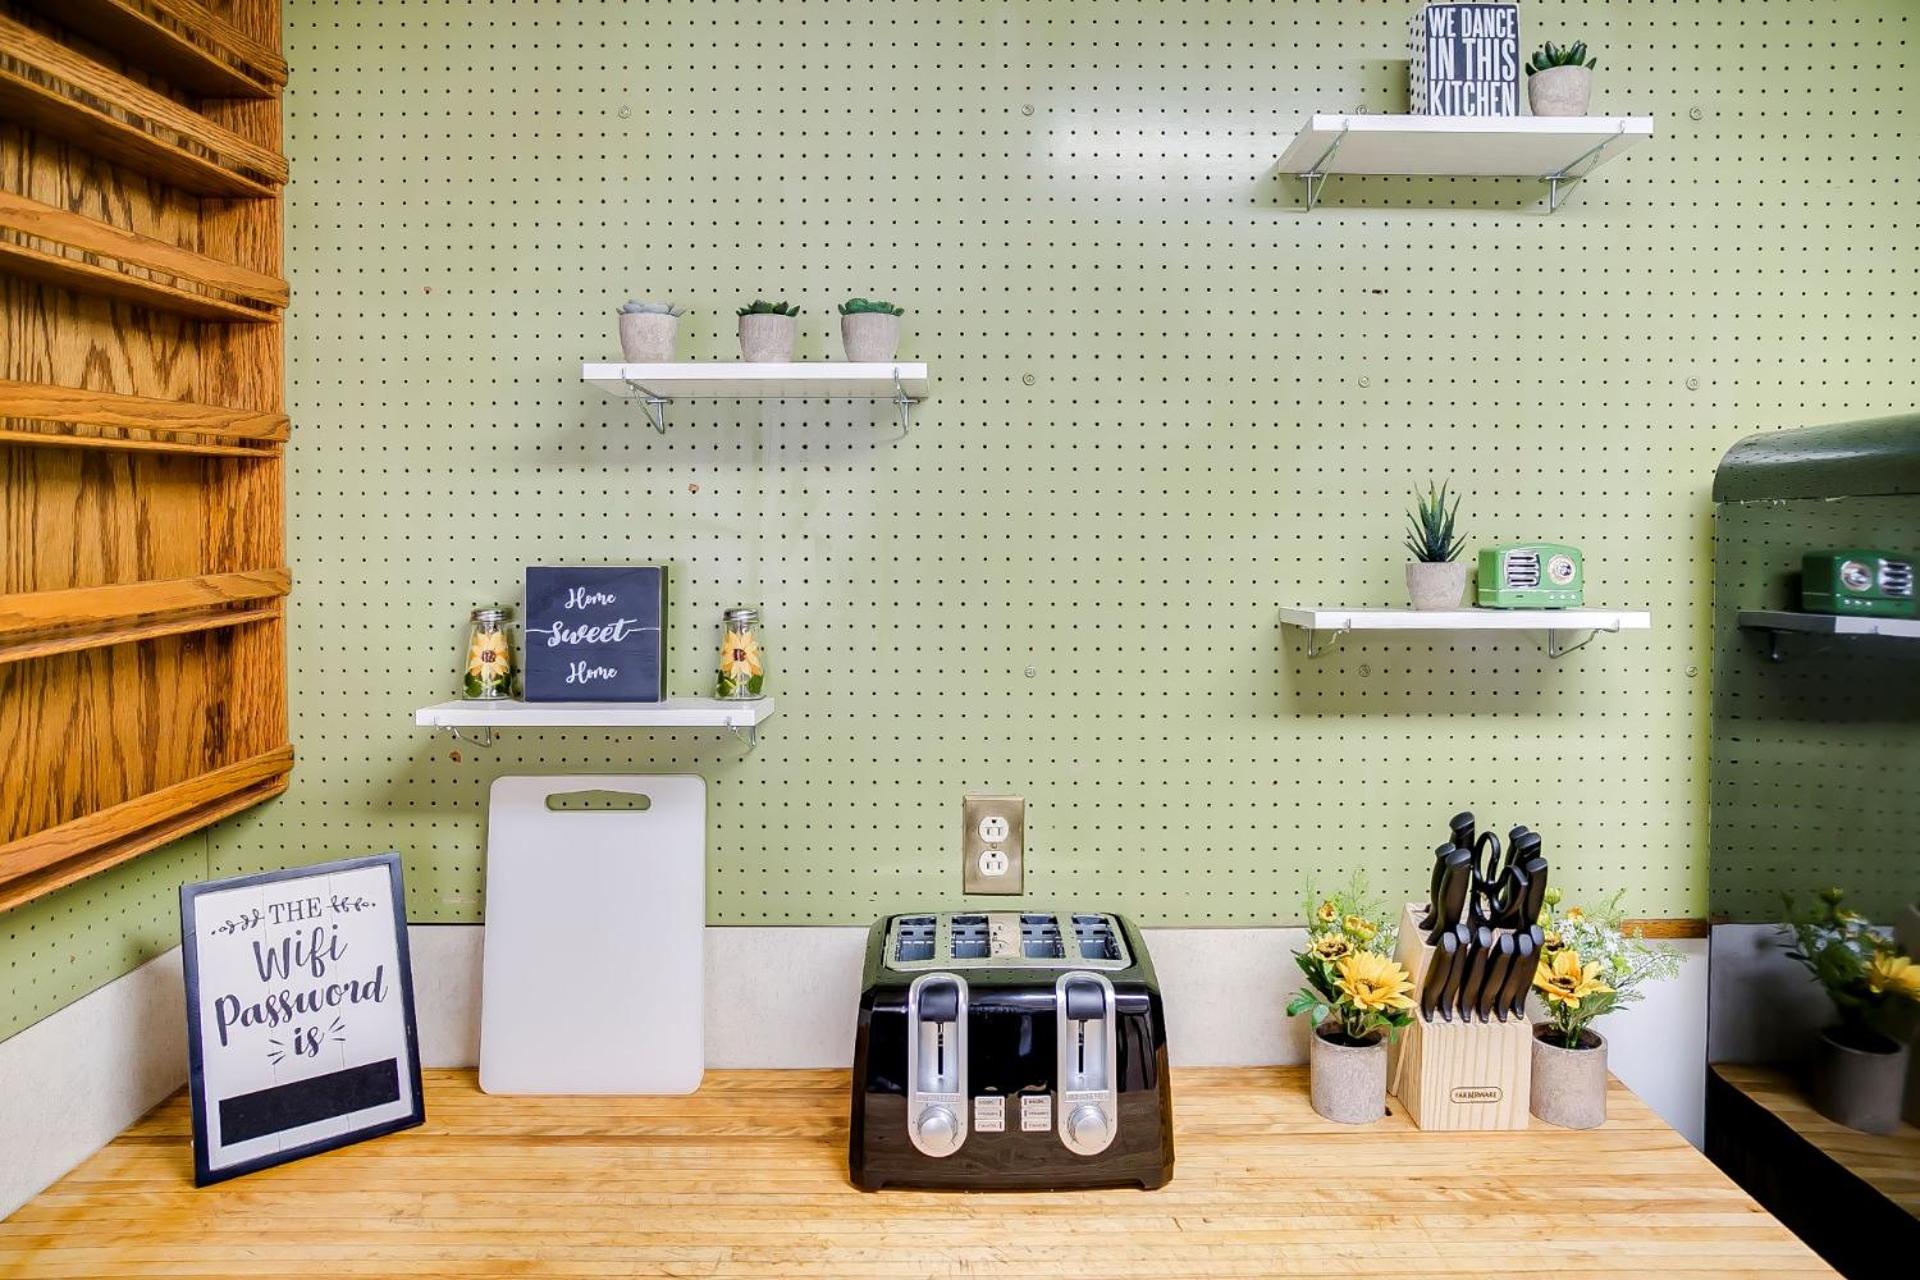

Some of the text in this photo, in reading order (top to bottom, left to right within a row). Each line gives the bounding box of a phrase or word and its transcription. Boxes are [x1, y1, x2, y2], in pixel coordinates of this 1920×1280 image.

[1427, 7, 1516, 39] WE DANCE
[1429, 38, 1516, 82] IN THIS
[1430, 80, 1516, 117] KITCHEN
[564, 586, 617, 610] Home
[547, 618, 638, 648] Sweet
[565, 660, 618, 684] Home
[268, 896, 323, 925] THE
[252, 923, 348, 983] Wifi
[214, 964, 389, 1048] Password
[294, 1025, 325, 1058] is
